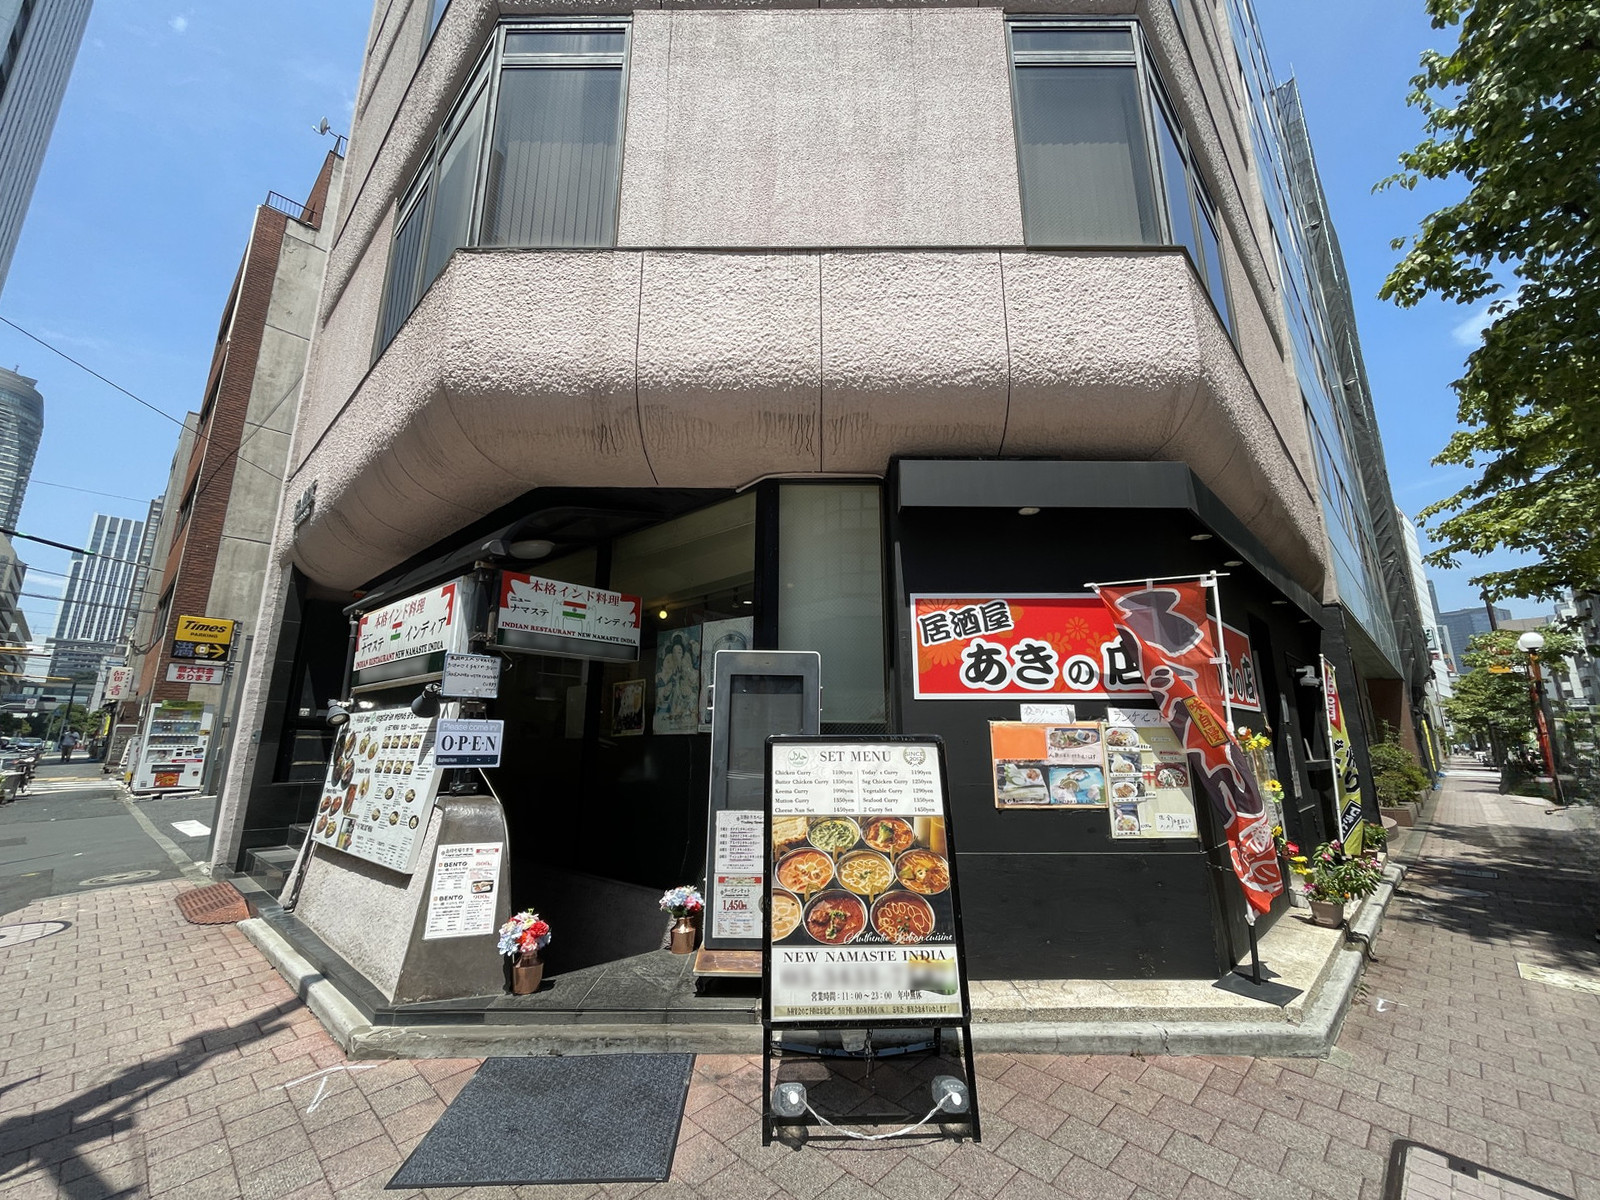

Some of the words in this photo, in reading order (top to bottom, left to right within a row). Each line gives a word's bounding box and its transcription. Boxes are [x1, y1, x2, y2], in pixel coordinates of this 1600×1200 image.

[510, 595, 531, 603] ニュー
[530, 580, 620, 607] 本格インド料理
[374, 598, 427, 628] 本格インド料理
[509, 604, 550, 616] ナマステ
[183, 620, 228, 632] Times
[404, 617, 447, 641] インディア
[595, 615, 636, 628] インディア
[921, 603, 1012, 642] 居酒屋
[501, 621, 529, 631] INDIAN
[530, 624, 576, 636] RESTAURANT
[577, 630, 592, 638] NEW
[592, 632, 619, 642] NAMASTE
[620, 636, 637, 644] INDIA
[360, 638, 385, 656] ナマステ
[355, 659, 369, 669] INDIAN
[369, 651, 395, 666] RESTAURANT
[395, 649, 405, 660] NEW
[405, 644, 427, 656] NAMASTE
[427, 641, 444, 652] INDIA
[176, 673, 214, 681] あります
[177, 665, 215, 674] 最大料金
[1188, 698, 1224, 744] 味自慢
[819, 751, 845, 761] SET
[851, 751, 891, 761] MENU
[783, 952, 818, 963] NEW
[825, 951, 897, 963] NAMASTE
[903, 950, 946, 962] INDIA
